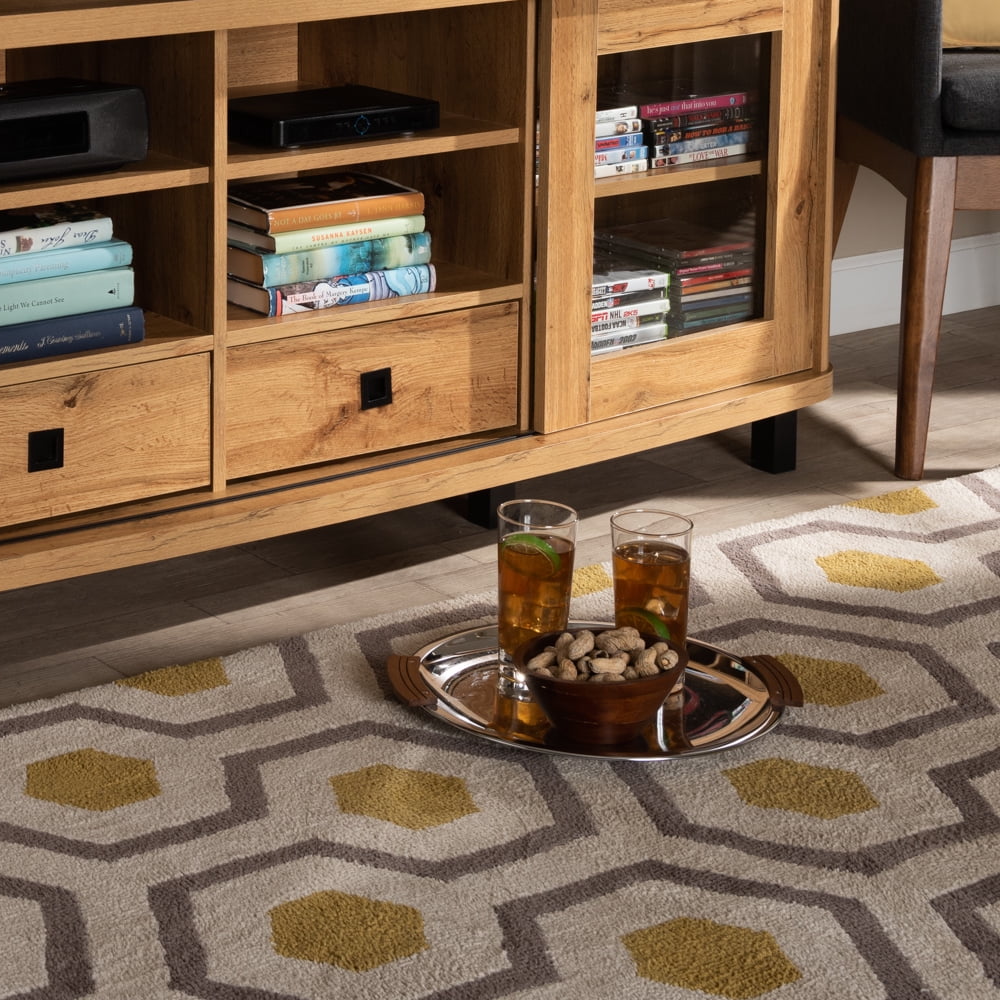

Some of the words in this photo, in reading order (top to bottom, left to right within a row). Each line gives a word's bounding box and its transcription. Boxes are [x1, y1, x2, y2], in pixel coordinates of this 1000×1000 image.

[658, 104, 670, 115] just
[681, 101, 693, 110] that
[311, 231, 344, 242] SUSANNA
[346, 228, 373, 237] KAYSEN
[3, 301, 19, 312] Light
[20, 301, 30, 309] We
[31, 299, 53, 308] Cannot
[54, 296, 65, 304] See
[302, 293, 317, 301] Book
[609, 309, 622, 319] NHL
